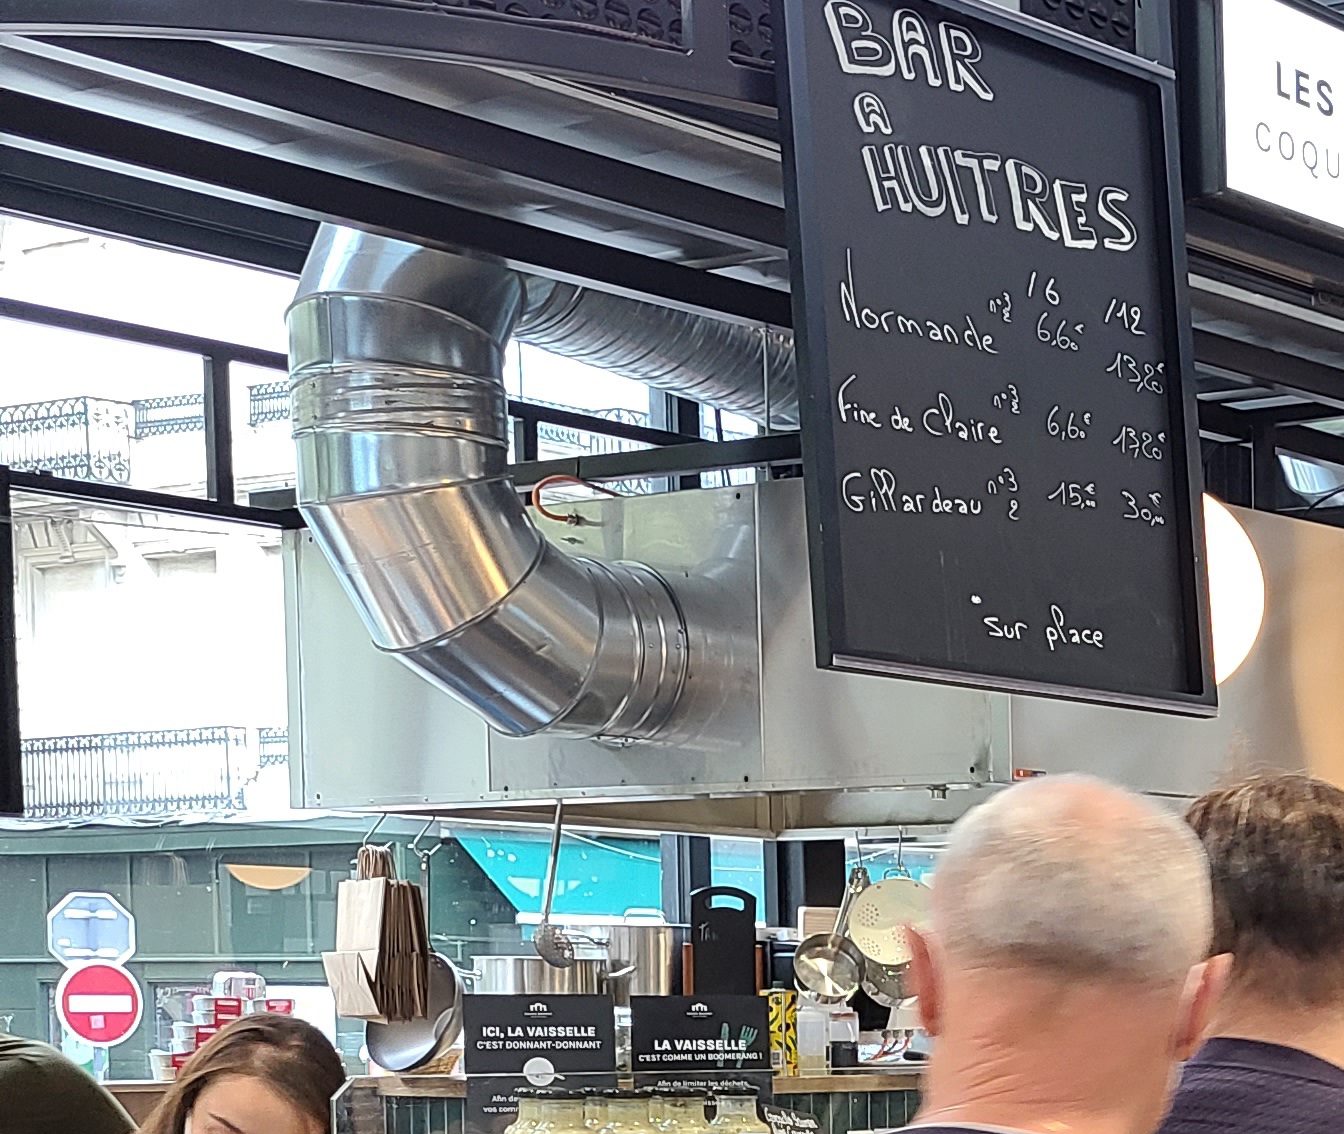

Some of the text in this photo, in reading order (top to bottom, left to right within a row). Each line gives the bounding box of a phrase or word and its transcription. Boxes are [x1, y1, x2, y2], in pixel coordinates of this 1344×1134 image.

[824, 0, 994, 101] BAR
[1275, 60, 1335, 117] LES
[853, 92, 892, 134] A
[860, 143, 1139, 252] HUITRES
[840, 248, 999, 354] Normande
[838, 374, 883, 428] Fine
[891, 406, 914, 433] de
[922, 392, 1003, 444] Claire
[841, 467, 983, 515] Gillardeau
[1046, 604, 1104, 650] place
[476, 1040, 602, 1050] C'EST DONNANT-DONNANT
[482, 1026, 596, 1039] ICI, LA VAISSELLE
[654, 1039, 747, 1051] LA VAISSELLE
[638, 1053, 661, 1062] C'EST
[662, 1053, 693, 1061] COMME
[694, 1053, 707, 1061] UN
[707, 1052, 758, 1060] BOOMERANG
